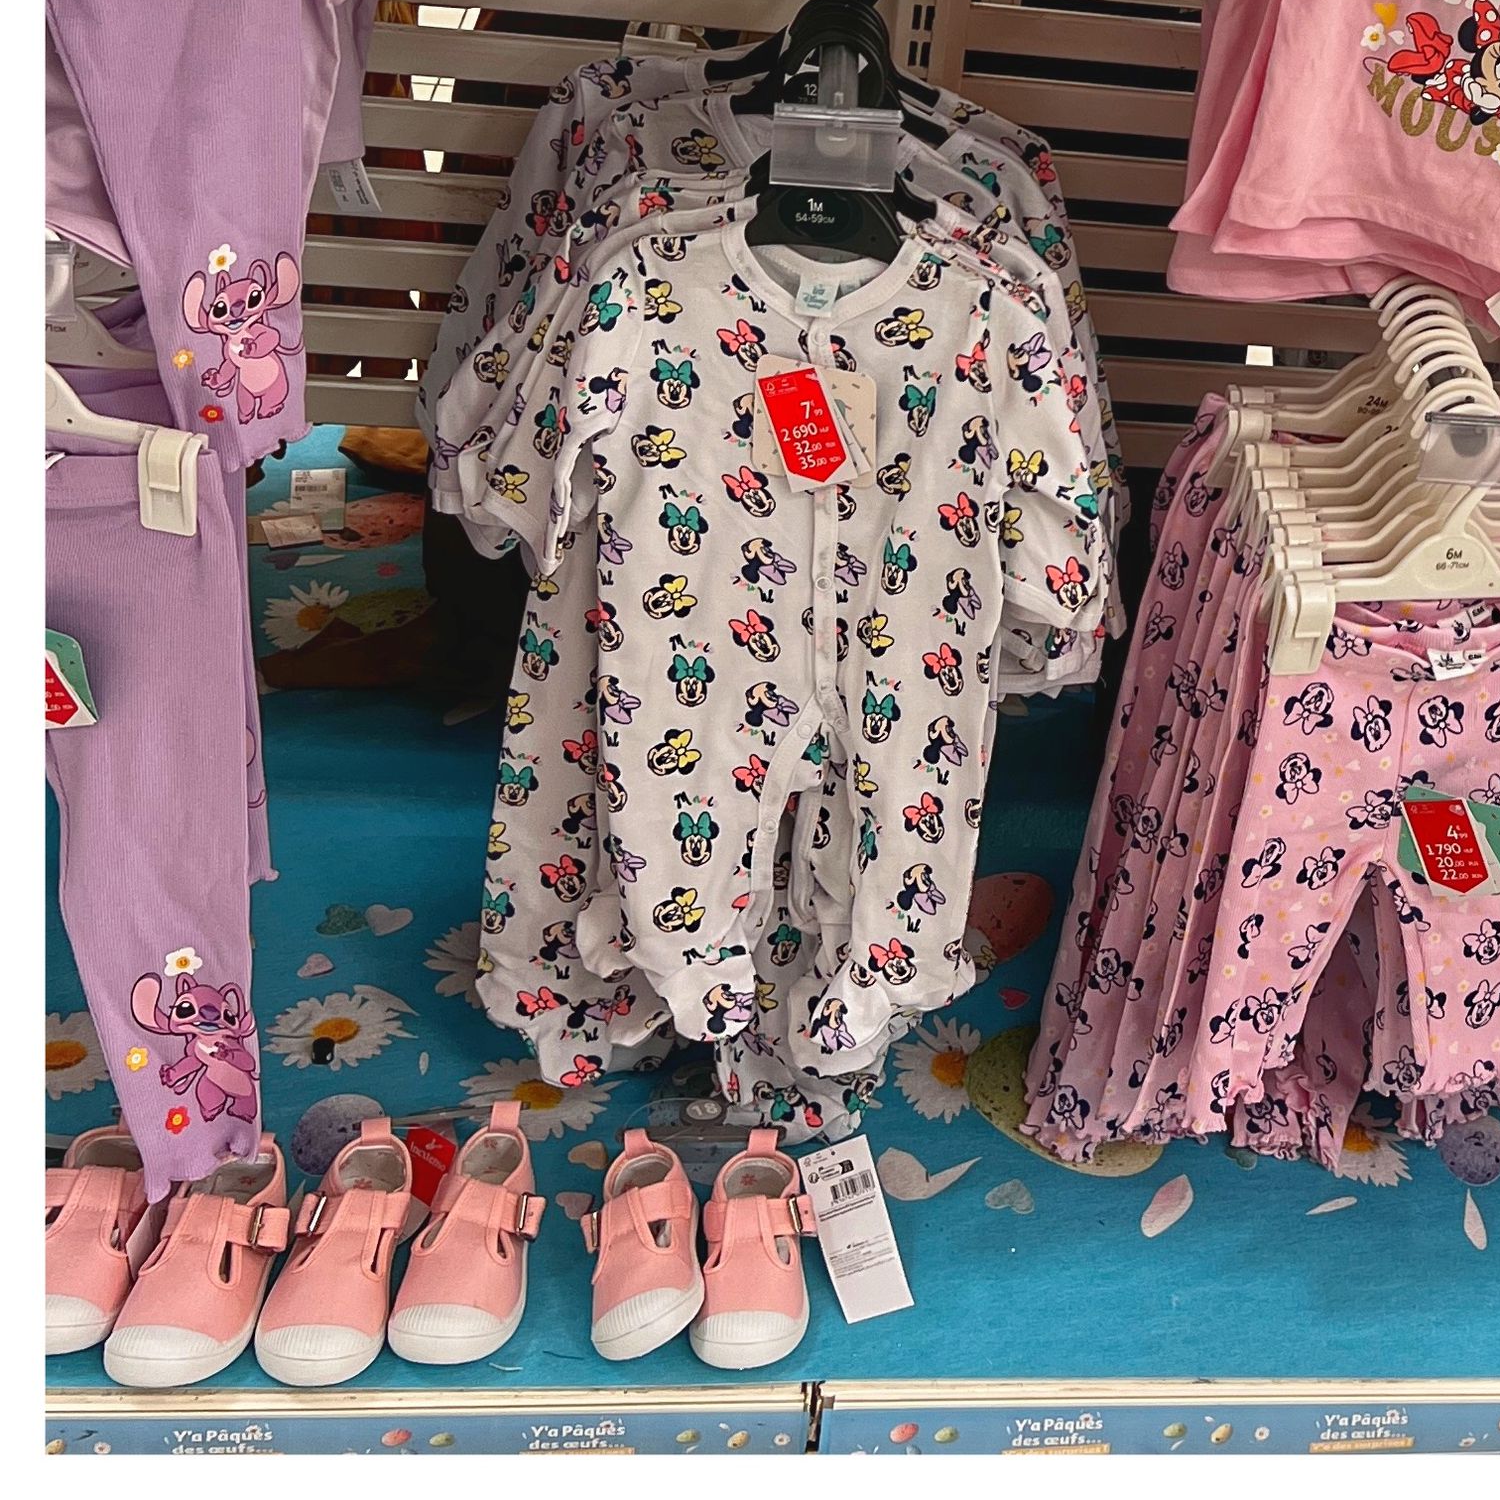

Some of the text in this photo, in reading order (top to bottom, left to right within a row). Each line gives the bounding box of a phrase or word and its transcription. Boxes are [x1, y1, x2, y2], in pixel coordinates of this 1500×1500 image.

[804, 83, 818, 97] 12
[807, 197, 824, 212] 1M
[795, 211, 836, 224] 54-59CM
[1366, 396, 1388, 409] 24M
[1446, 548, 1463, 560] 6M
[1015, 1416, 1104, 1432] Y'a Pâques
[1325, 1413, 1409, 1428] Y'a Pâques
[173, 1427, 273, 1445] Y'a Pâques
[531, 1423, 626, 1440] Y'a Pâques
[1319, 1428, 1347, 1440] des
[529, 1440, 559, 1450] des
[1012, 1434, 1040, 1447] des
